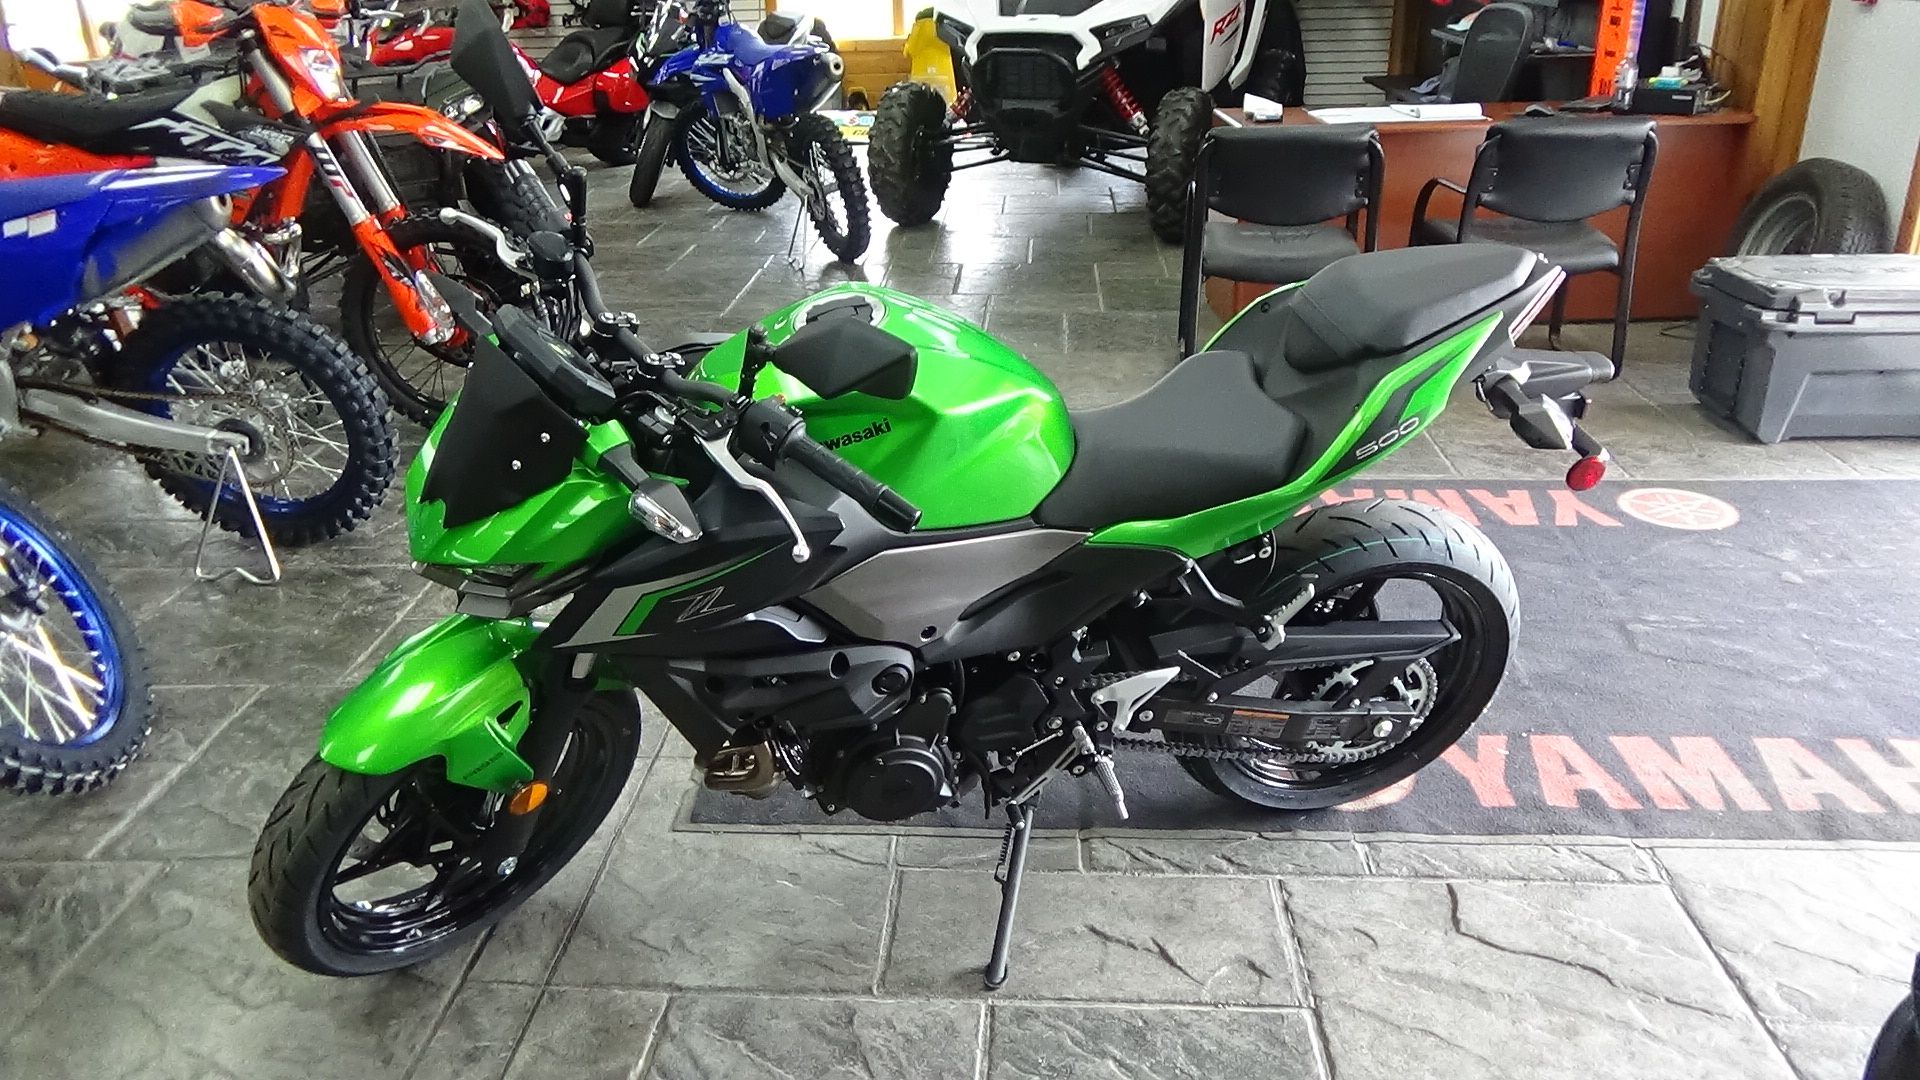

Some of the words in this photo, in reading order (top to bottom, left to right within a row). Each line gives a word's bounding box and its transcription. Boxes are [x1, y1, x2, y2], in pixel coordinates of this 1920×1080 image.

[820, 417, 892, 452] wasaki
[1355, 416, 1420, 460] 500
[671, 585, 736, 624] Z
